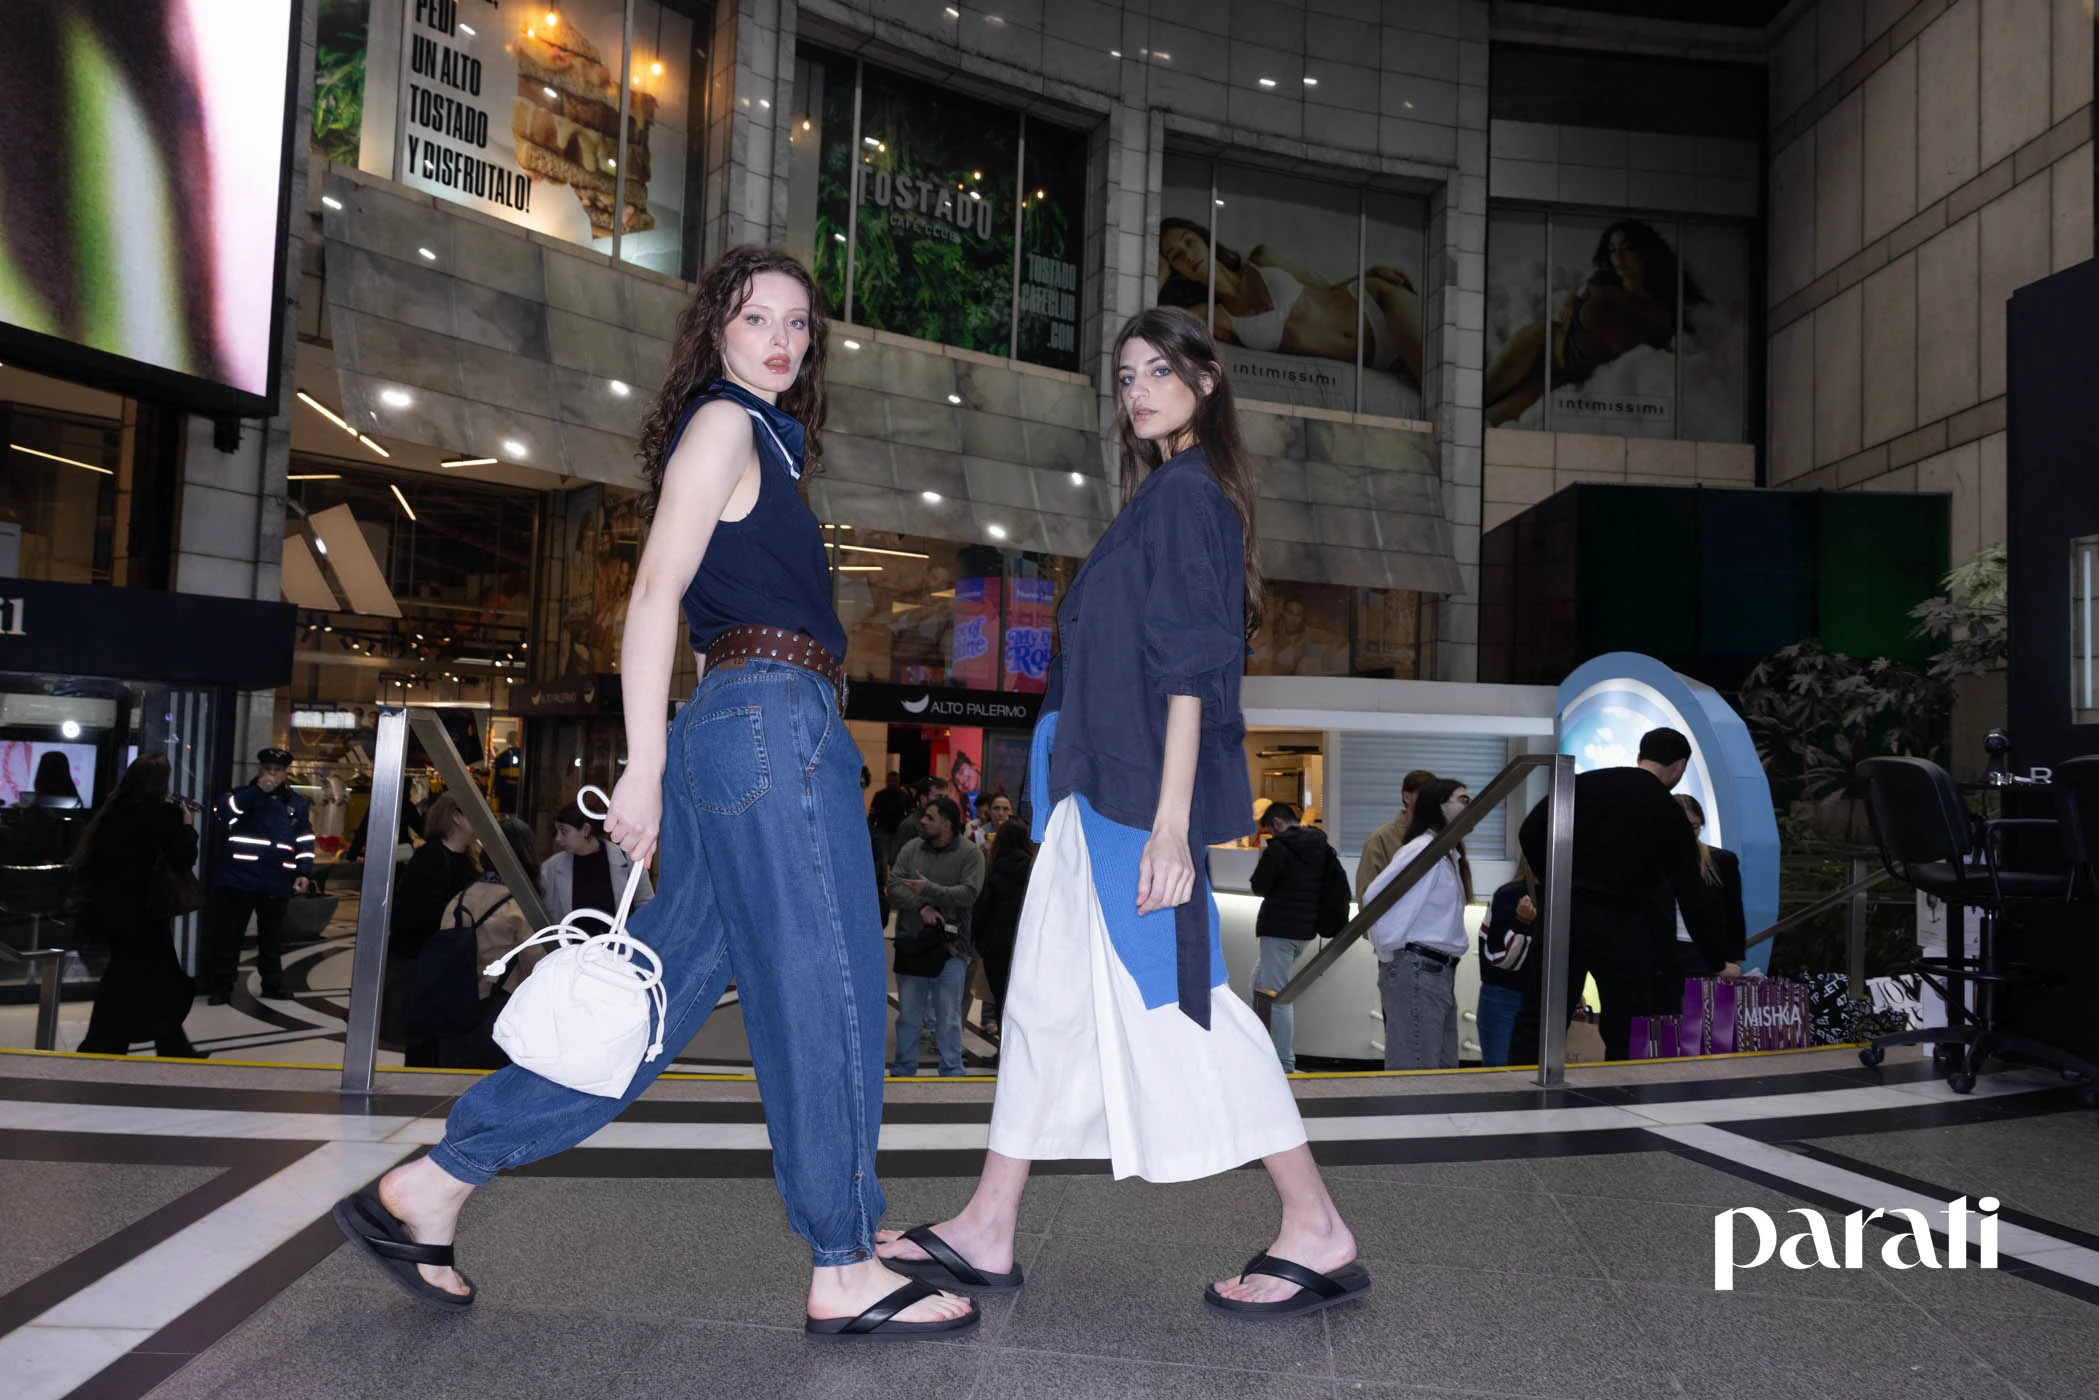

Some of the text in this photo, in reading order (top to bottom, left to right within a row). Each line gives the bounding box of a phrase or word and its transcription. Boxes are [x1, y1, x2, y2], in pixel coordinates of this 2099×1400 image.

[411, 34, 482, 97] UN ALTO
[410, 83, 488, 149] TOSTADO
[408, 134, 532, 213] Y DISFRUTALO!
[857, 164, 993, 241] TOSTADO
[1232, 363, 1337, 385] intimissimi
[1559, 399, 1665, 415] intimissimi
[930, 701, 1027, 718] ALTO PALERMO
[1743, 1004, 1803, 1028] MISHKA
